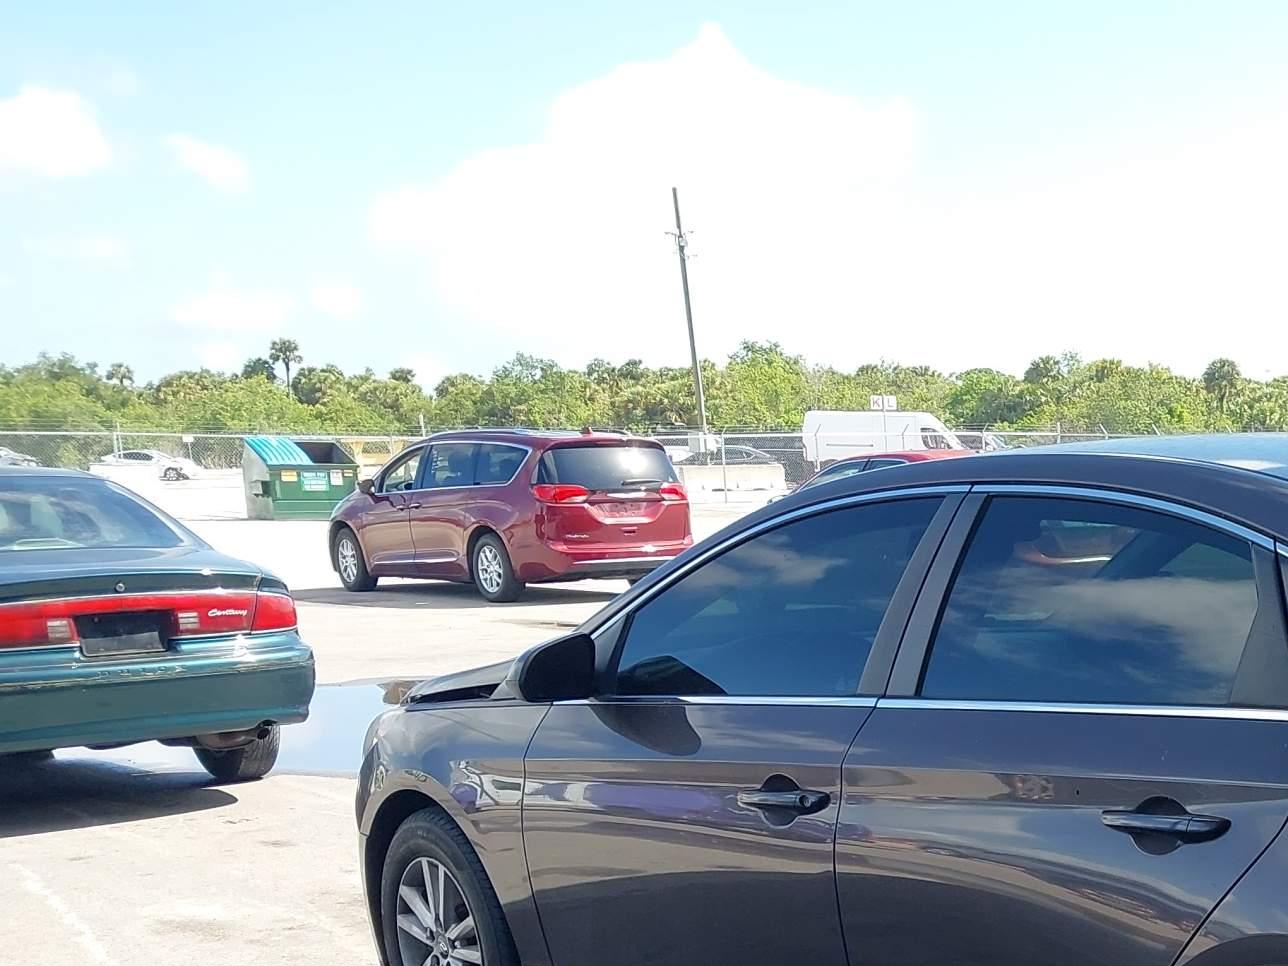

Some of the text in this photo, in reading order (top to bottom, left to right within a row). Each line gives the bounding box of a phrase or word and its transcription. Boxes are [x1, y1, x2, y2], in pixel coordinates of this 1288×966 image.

[872, 397, 895, 408] K L
[207, 608, 248, 617] Century
